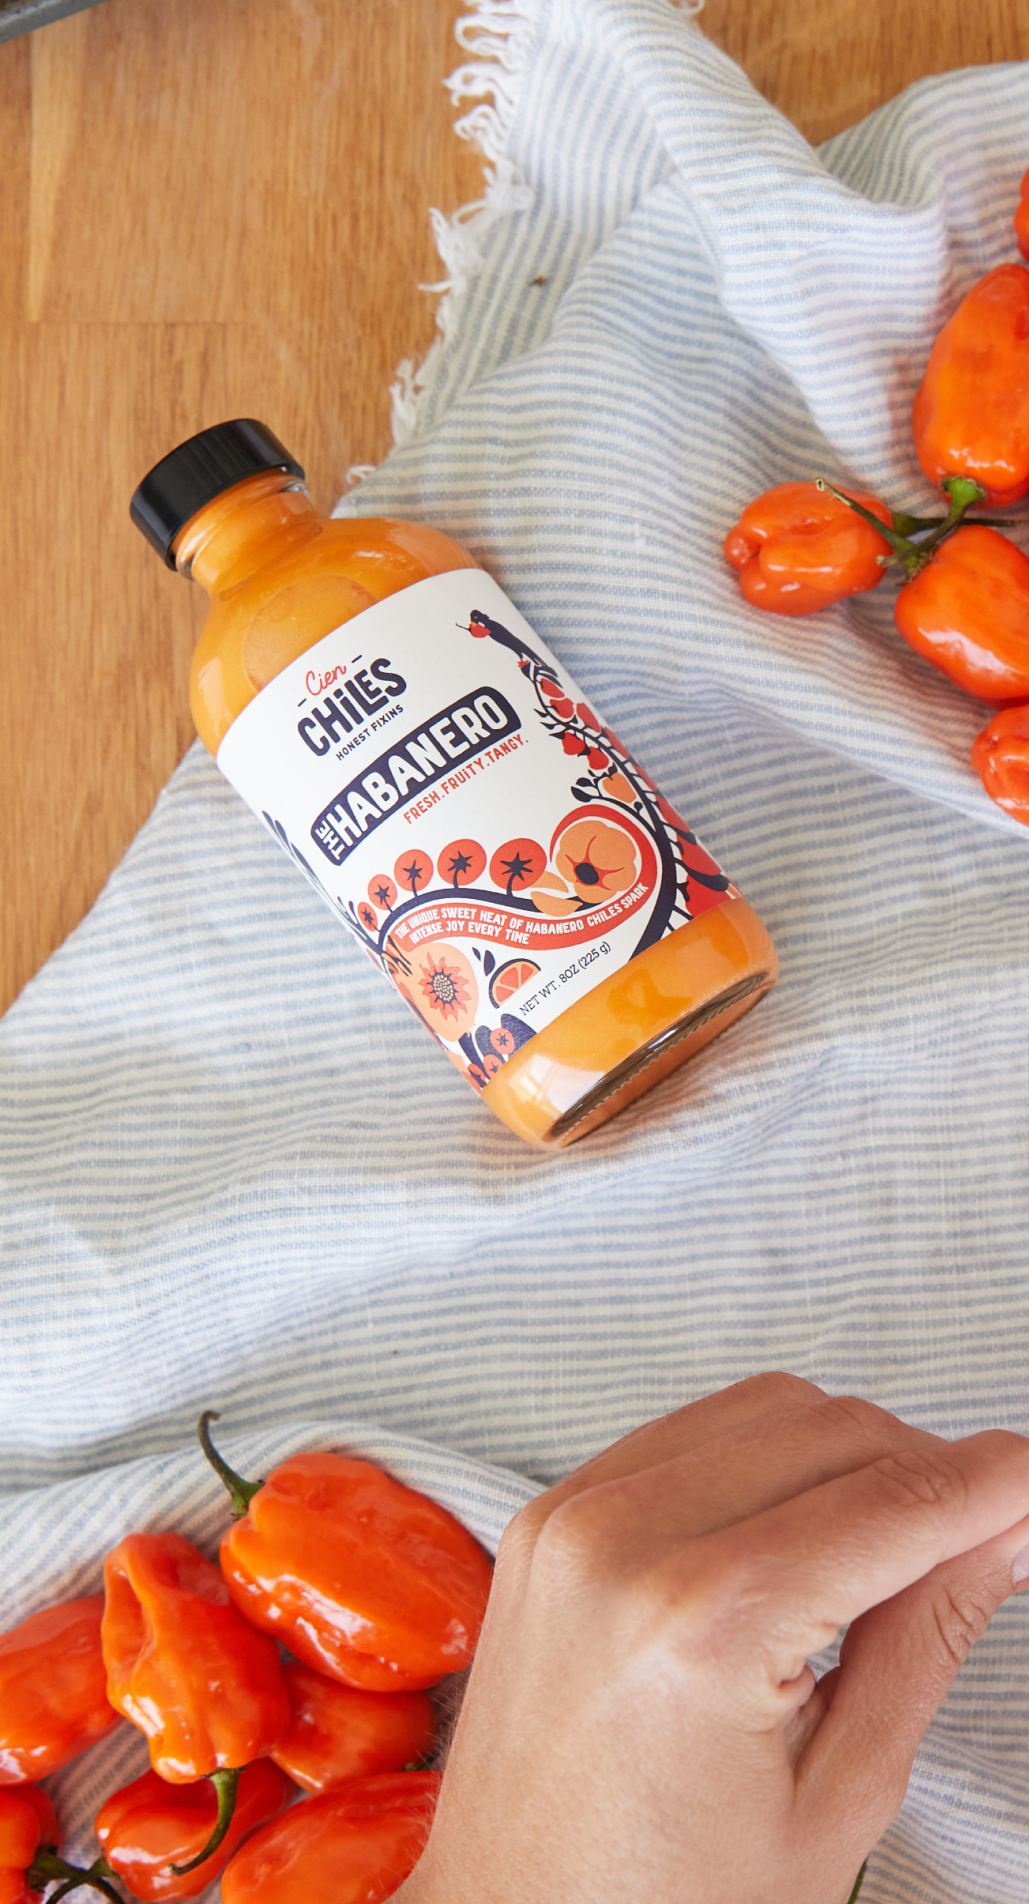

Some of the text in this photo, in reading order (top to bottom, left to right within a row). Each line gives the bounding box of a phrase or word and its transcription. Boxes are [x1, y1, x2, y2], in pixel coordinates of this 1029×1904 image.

[306, 665, 347, 696] Cien
[335, 704, 404, 761] HONEST FIXINS
[315, 694, 509, 860] THE HABANERO
[394, 922, 410, 939] THE
[441, 907, 477, 920] SWEET
[479, 910, 508, 926] HEAT
[509, 917, 524, 930] OF
[525, 919, 584, 935] HABANERO
[620, 882, 649, 909] SPARK
[409, 921, 444, 945] INTENSE
[446, 920, 466, 932] JOY
[467, 921, 502, 938] EVERY
[519, 941, 611, 1016] NET WT. 8OZ (225 g)
